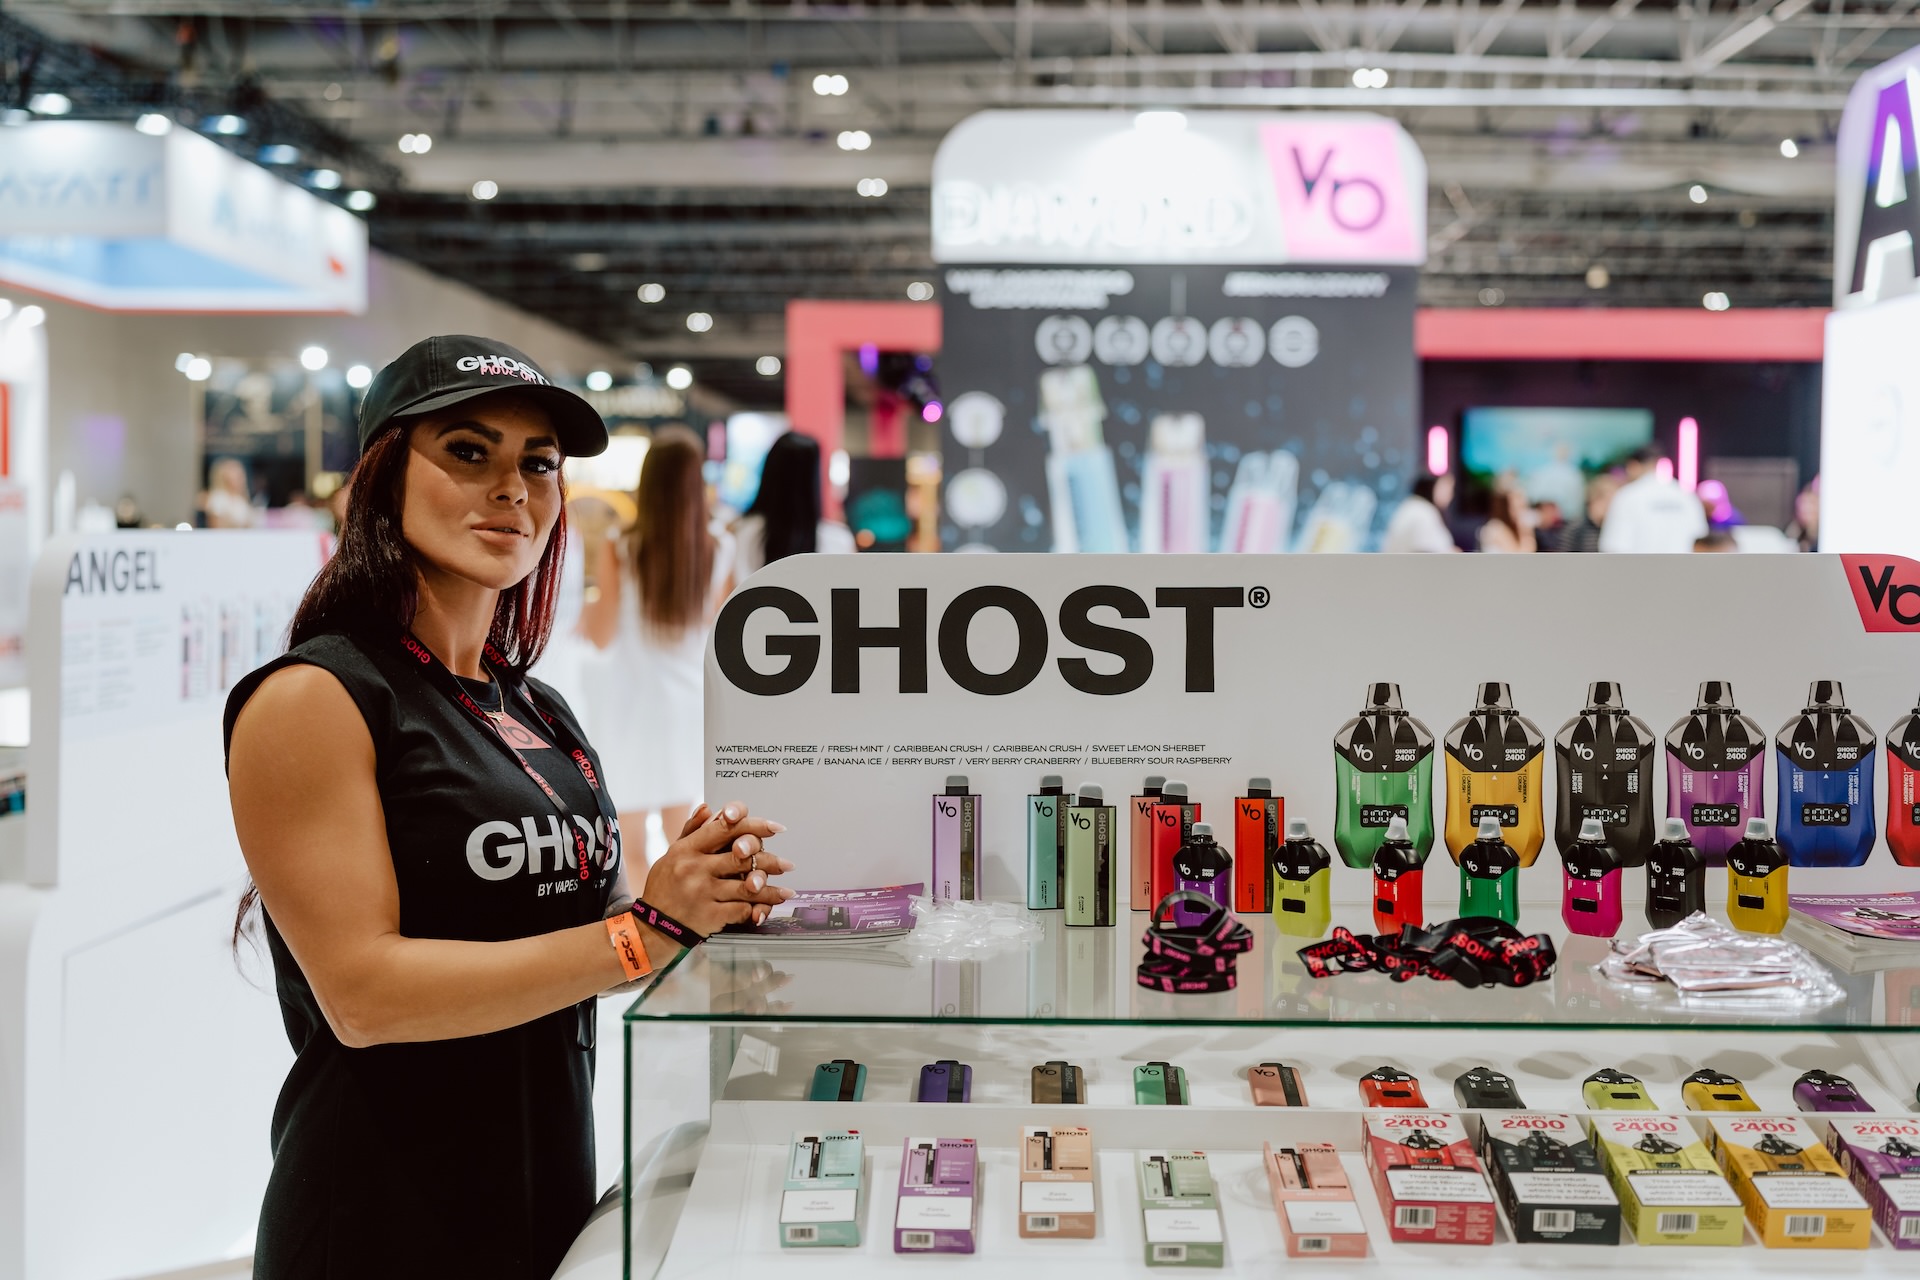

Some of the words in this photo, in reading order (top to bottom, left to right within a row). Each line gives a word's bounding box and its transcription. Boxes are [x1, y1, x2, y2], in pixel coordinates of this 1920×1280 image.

[64, 549, 162, 595] ANGEL
[715, 770, 739, 778] FIZZY
[741, 770, 778, 778] CHERRY
[1098, 813, 1106, 846] GHOST
[538, 884, 552, 897] BY
[555, 879, 579, 894] VAPES
[1384, 1119, 1447, 1128] 2400
[1501, 1120, 1565, 1129] 2400
[1613, 1123, 1677, 1132] 2400
[1730, 1123, 1796, 1133] 2400
